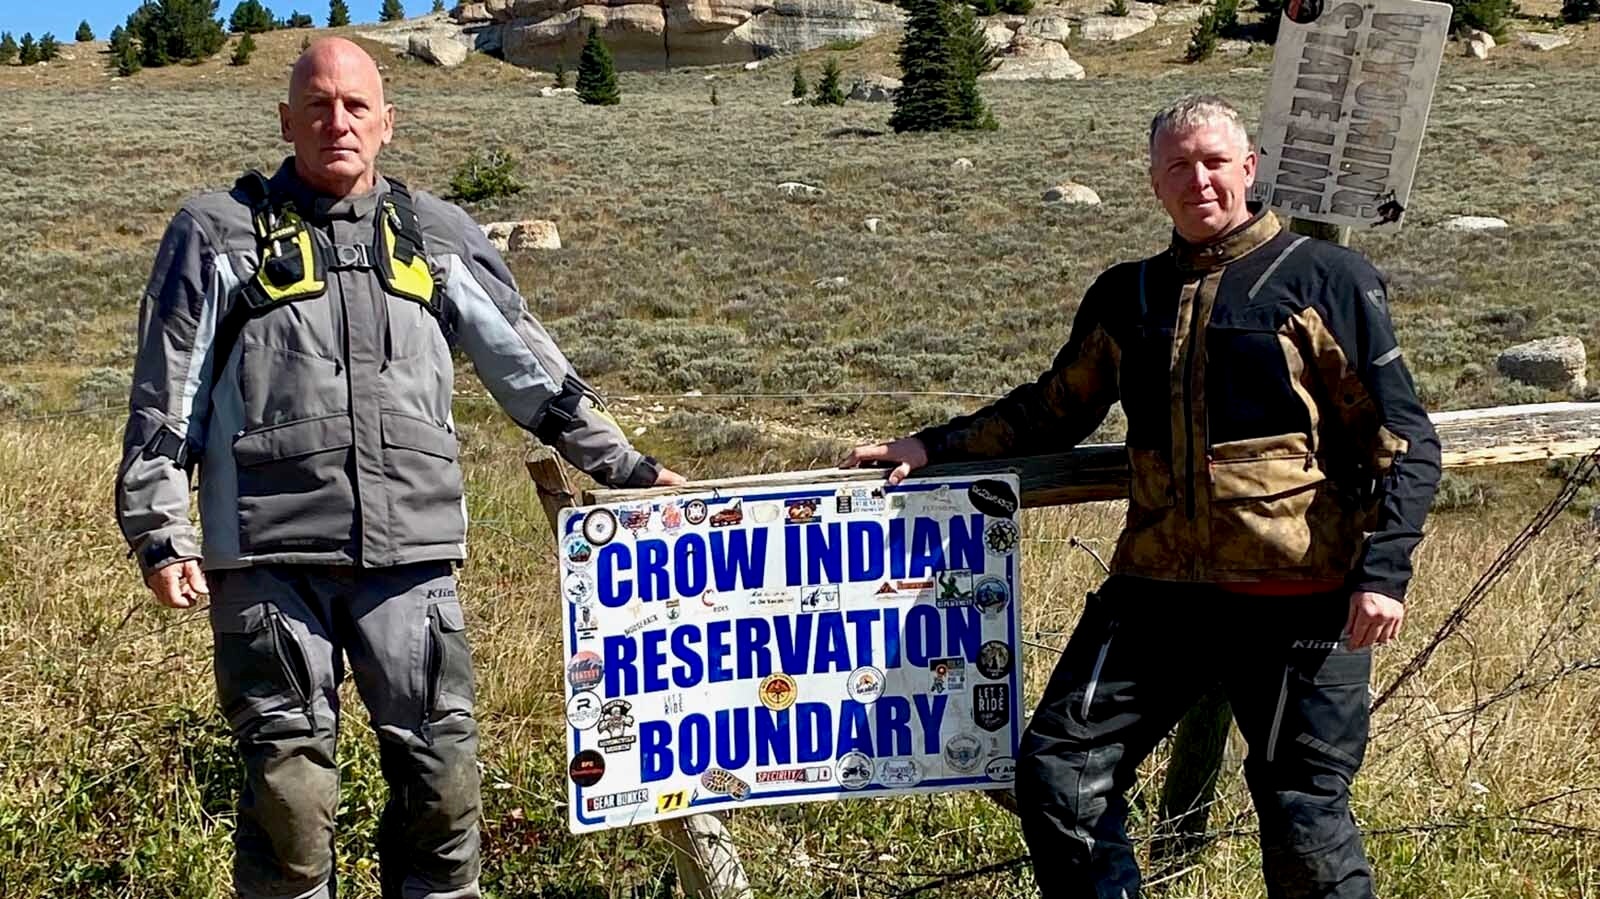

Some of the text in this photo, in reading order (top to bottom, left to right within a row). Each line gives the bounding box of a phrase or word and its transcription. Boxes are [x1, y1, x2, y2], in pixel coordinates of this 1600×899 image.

[1272, 3, 1363, 213] STATE LINE
[597, 527, 769, 608] CROW
[785, 514, 984, 585] INDIAN
[603, 602, 981, 699] RESERVATION
[639, 692, 949, 784] BOUNDARY
[978, 698, 1004, 711] RIDE
[593, 789, 648, 809] GEAR BUNKER
[662, 794, 684, 809] 71
